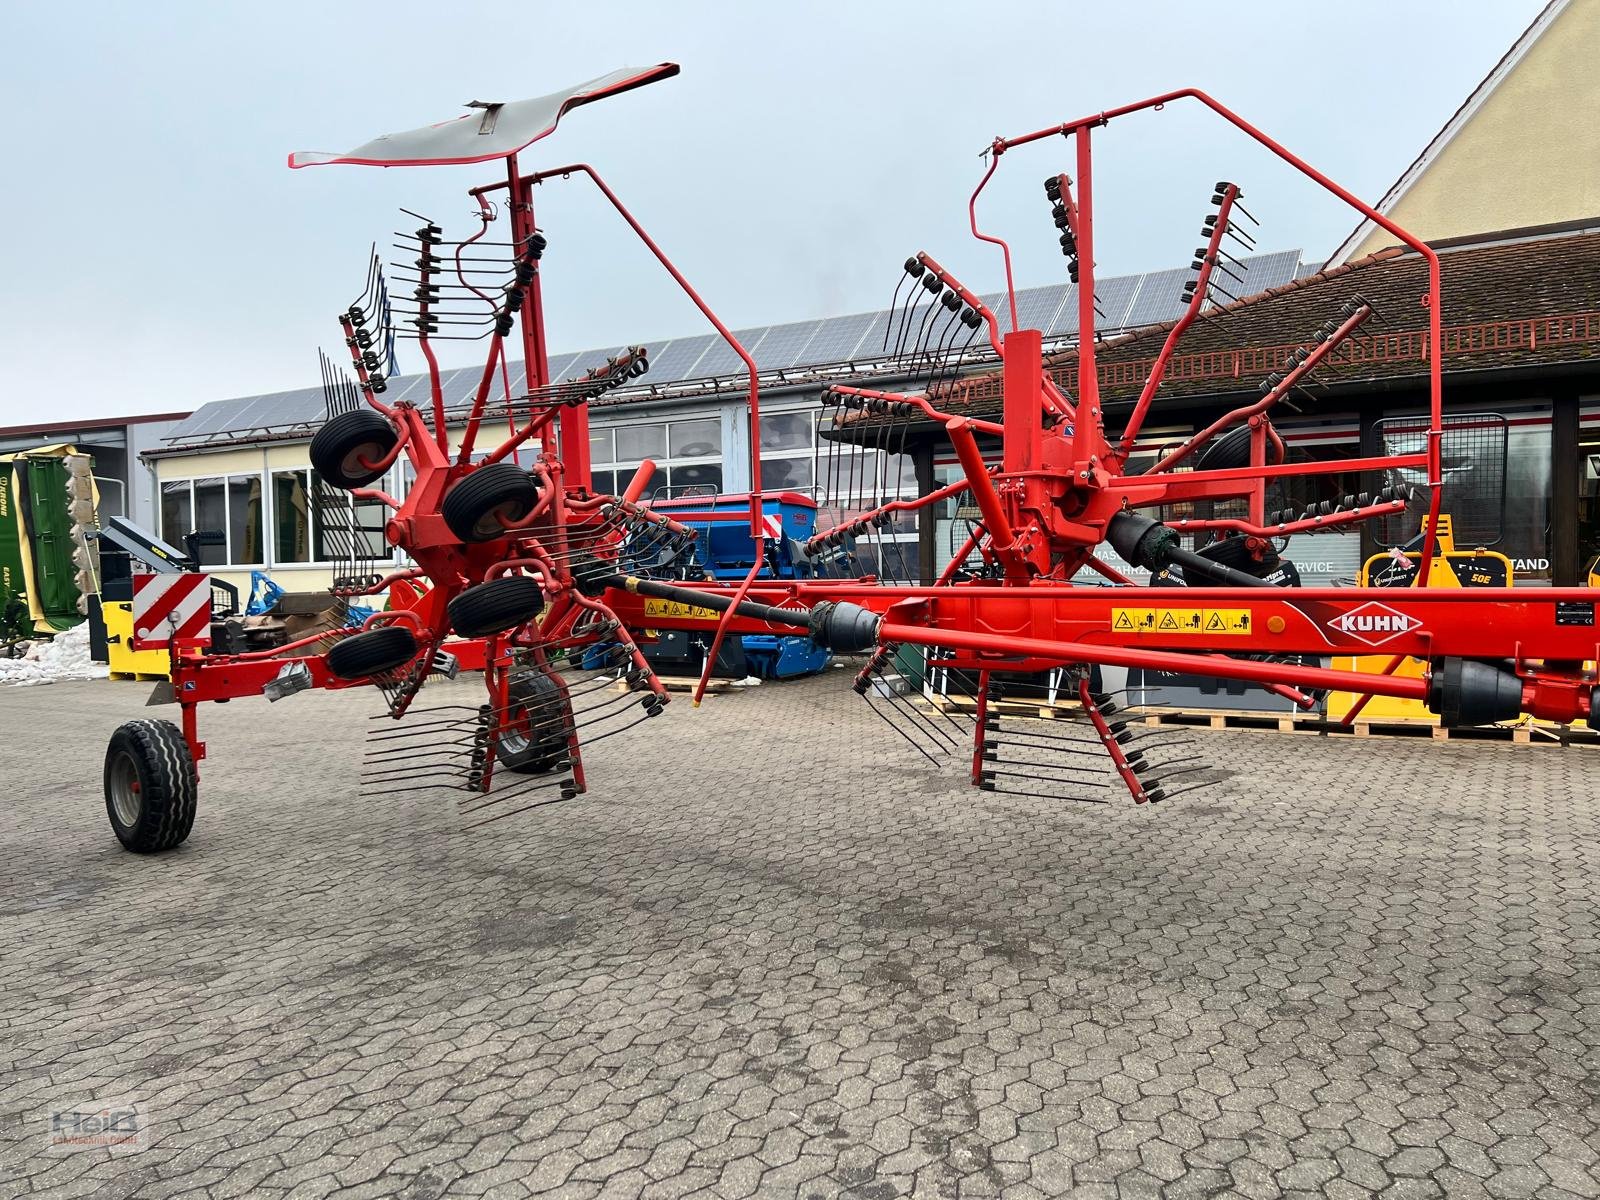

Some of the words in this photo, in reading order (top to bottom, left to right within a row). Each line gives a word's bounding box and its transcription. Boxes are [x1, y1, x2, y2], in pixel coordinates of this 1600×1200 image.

[0, 487, 8, 517] KRONE
[1293, 562, 1334, 573] RVICE
[1471, 573, 1492, 584] 50E
[1341, 615, 1408, 631] KUHN
